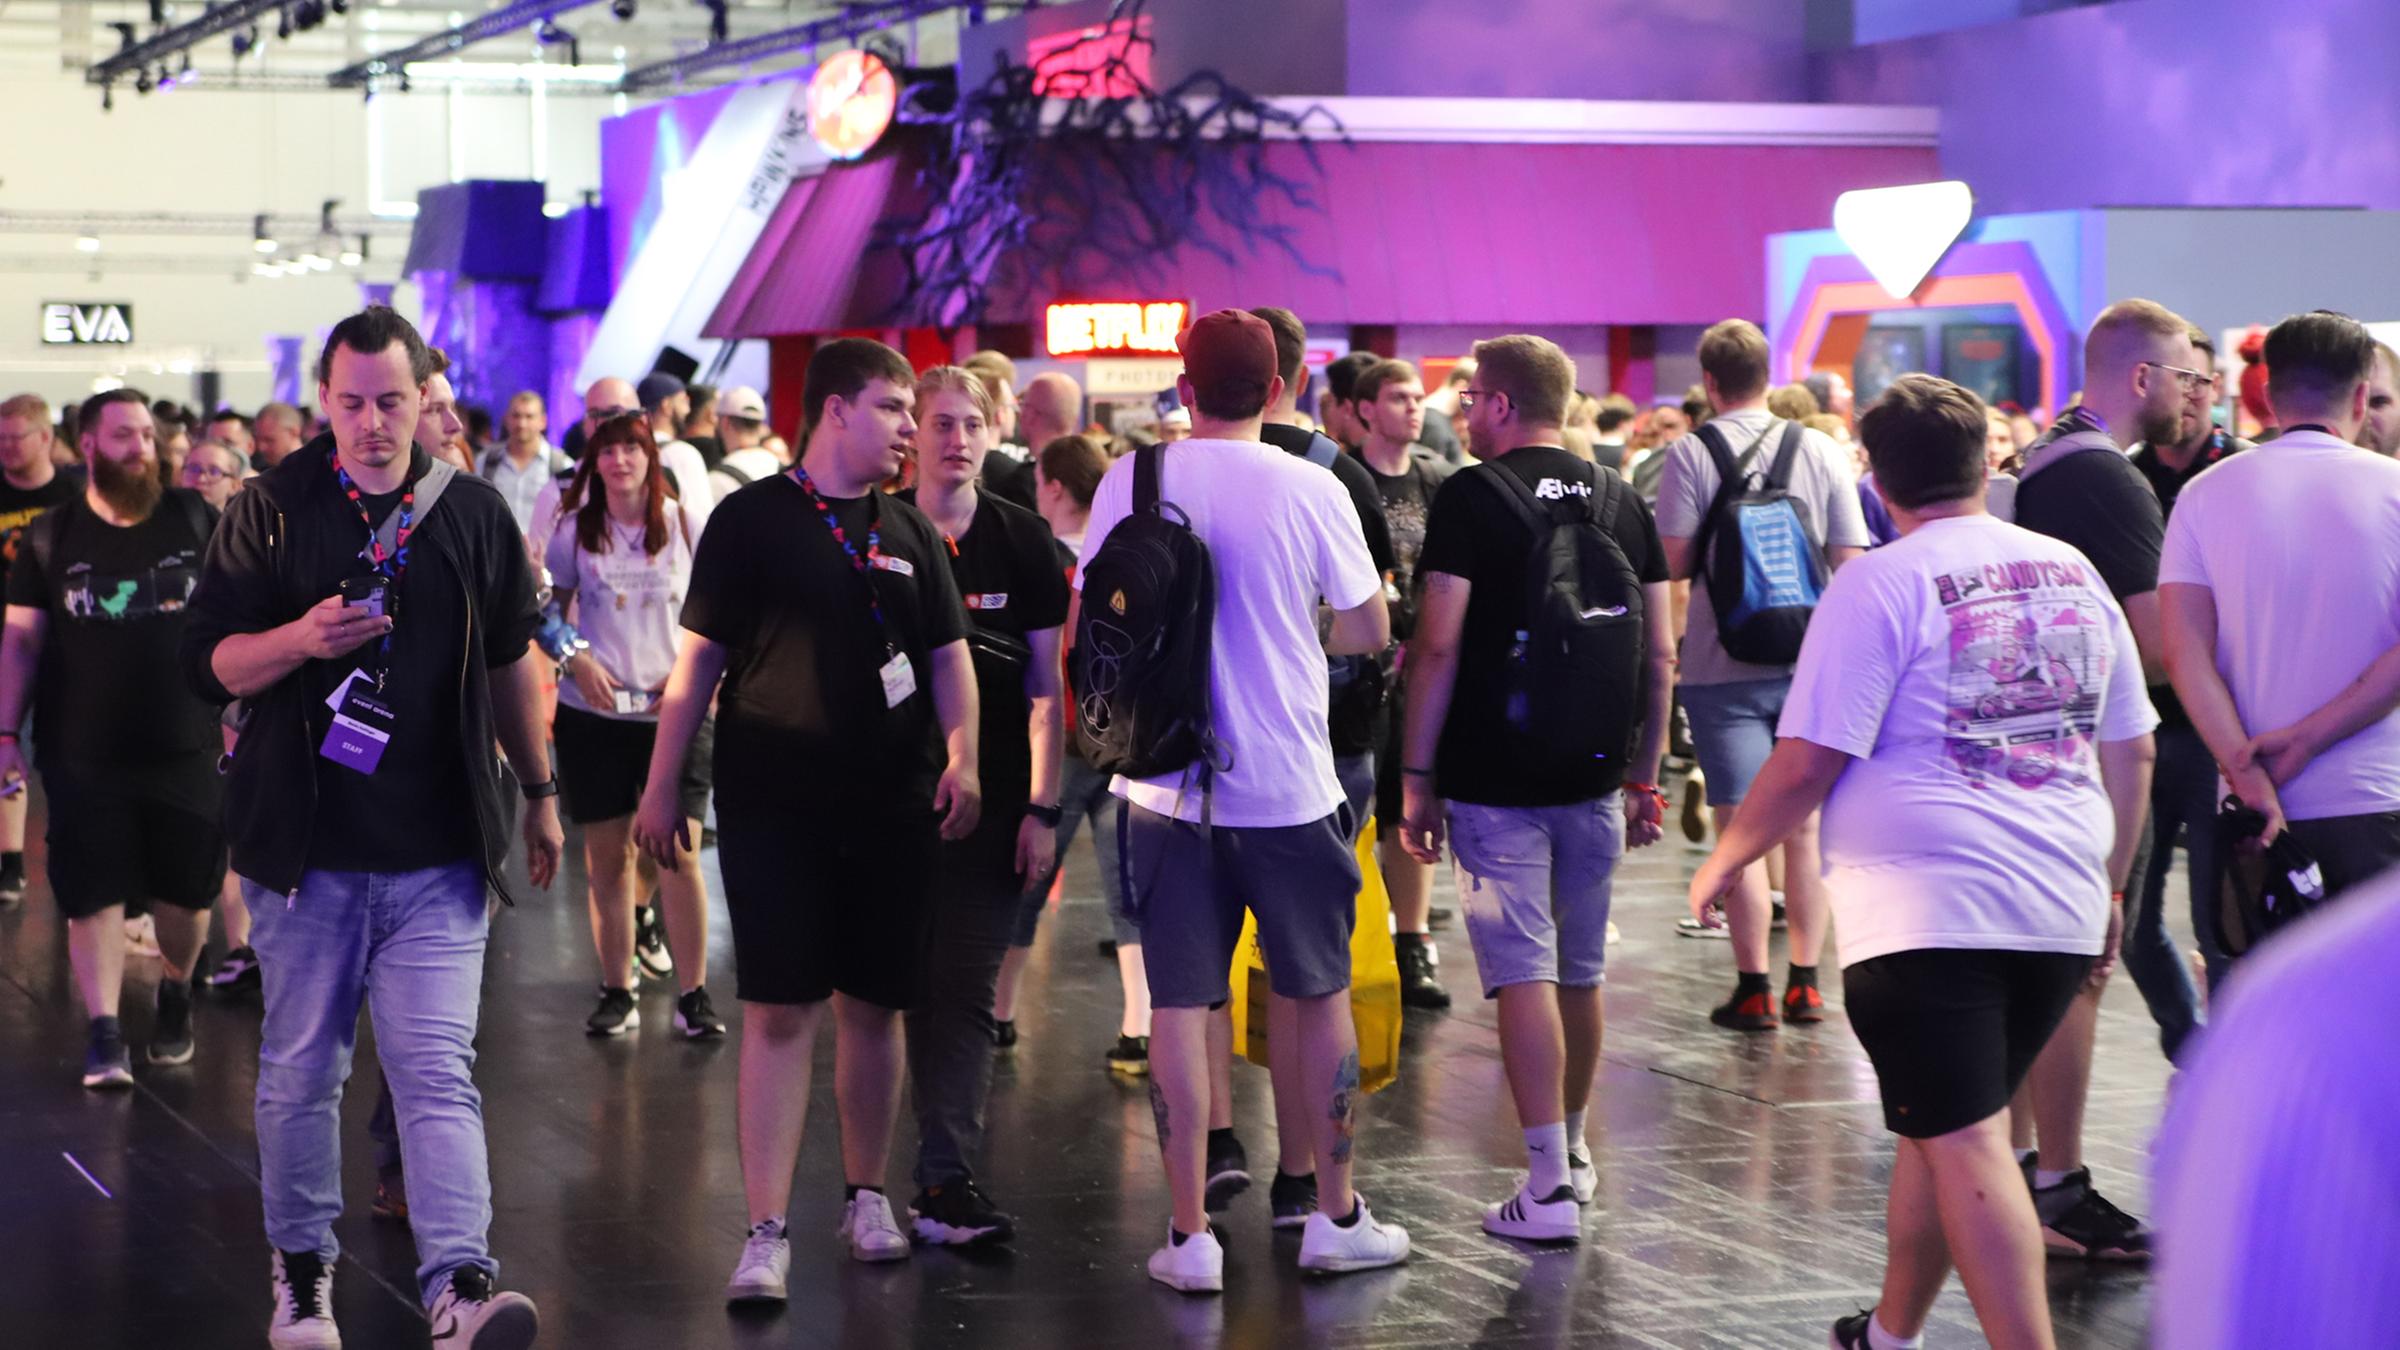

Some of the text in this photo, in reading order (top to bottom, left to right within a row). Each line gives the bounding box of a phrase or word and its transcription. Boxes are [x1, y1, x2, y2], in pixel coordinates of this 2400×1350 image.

[44, 303, 131, 342] EVA
[1047, 302, 1184, 354] NETFLIX
[351, 697, 396, 720] event arena
[341, 740, 364, 755] STAFF
